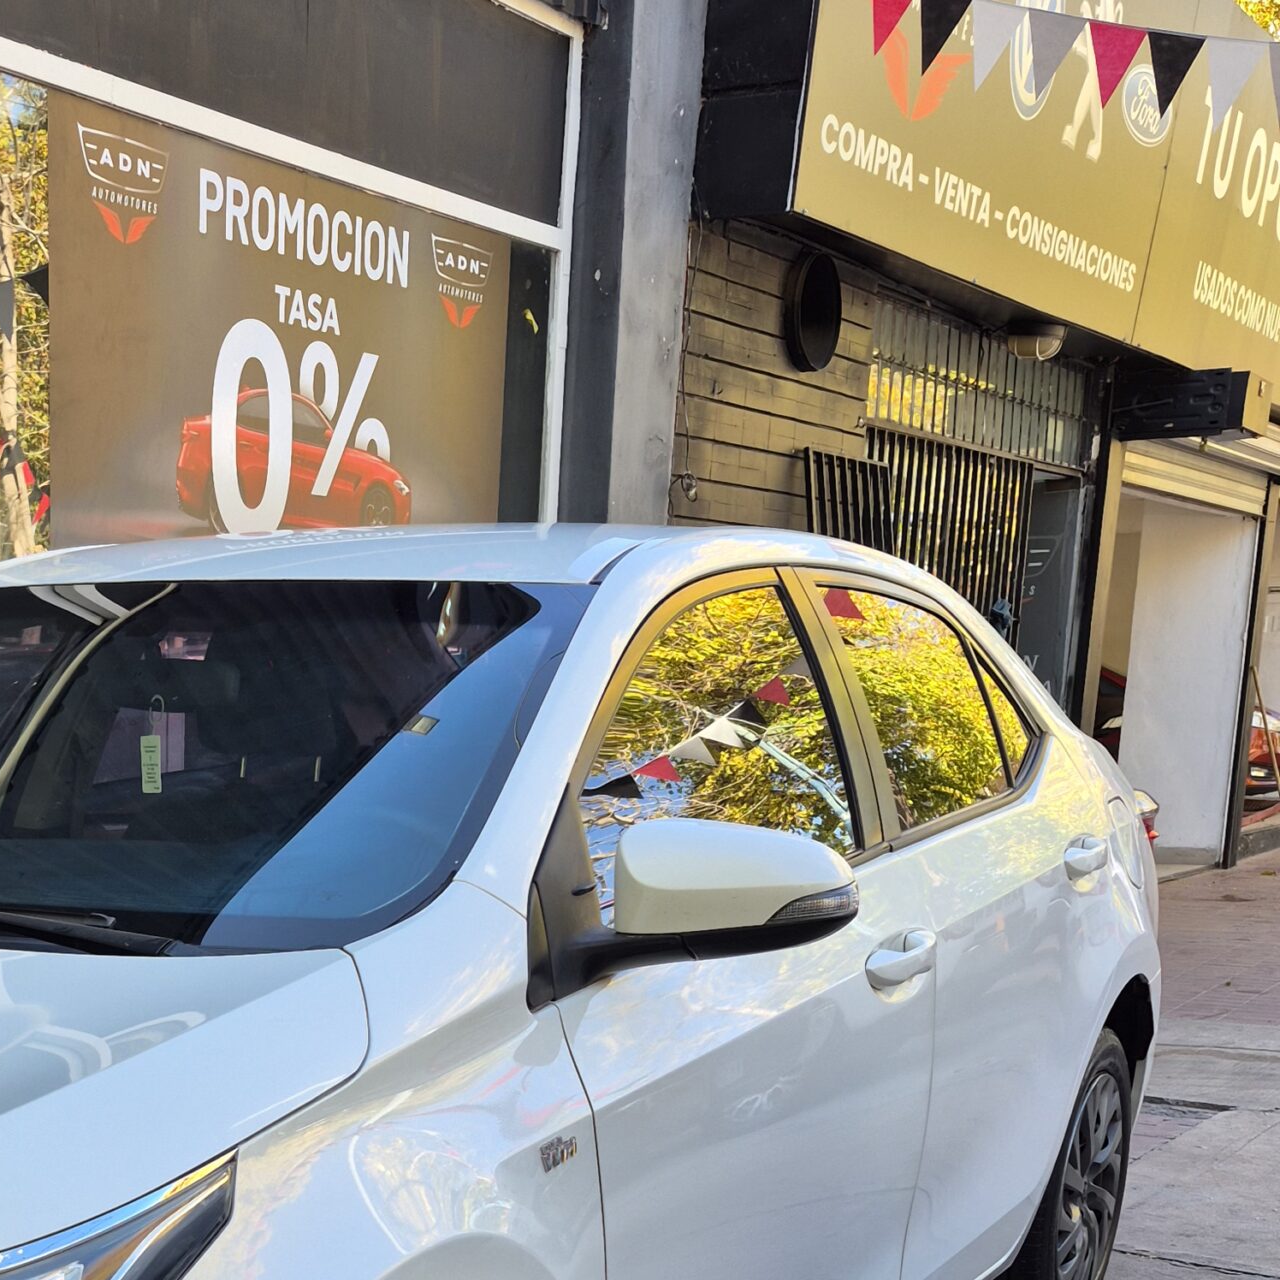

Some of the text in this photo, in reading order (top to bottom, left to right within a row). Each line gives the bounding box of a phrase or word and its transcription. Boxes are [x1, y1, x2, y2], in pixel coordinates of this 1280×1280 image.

[99, 147, 151, 178] ADN
[1241, 127, 1280, 242] OP
[91, 185, 158, 215] AUTOMOTORES
[198, 168, 410, 289] PROMOCION
[820, 113, 914, 192] COMPRA
[934, 167, 991, 228] VENTA
[1006, 206, 1137, 293] CONSIGNACIONES
[438, 283, 484, 304] AUTOMOTORES
[444, 252, 480, 275] ADN
[274, 284, 341, 337] TASA
[1193, 260, 1238, 317] USADOS
[1234, 284, 1266, 332] COMO
[212, 318, 391, 534] 0%
